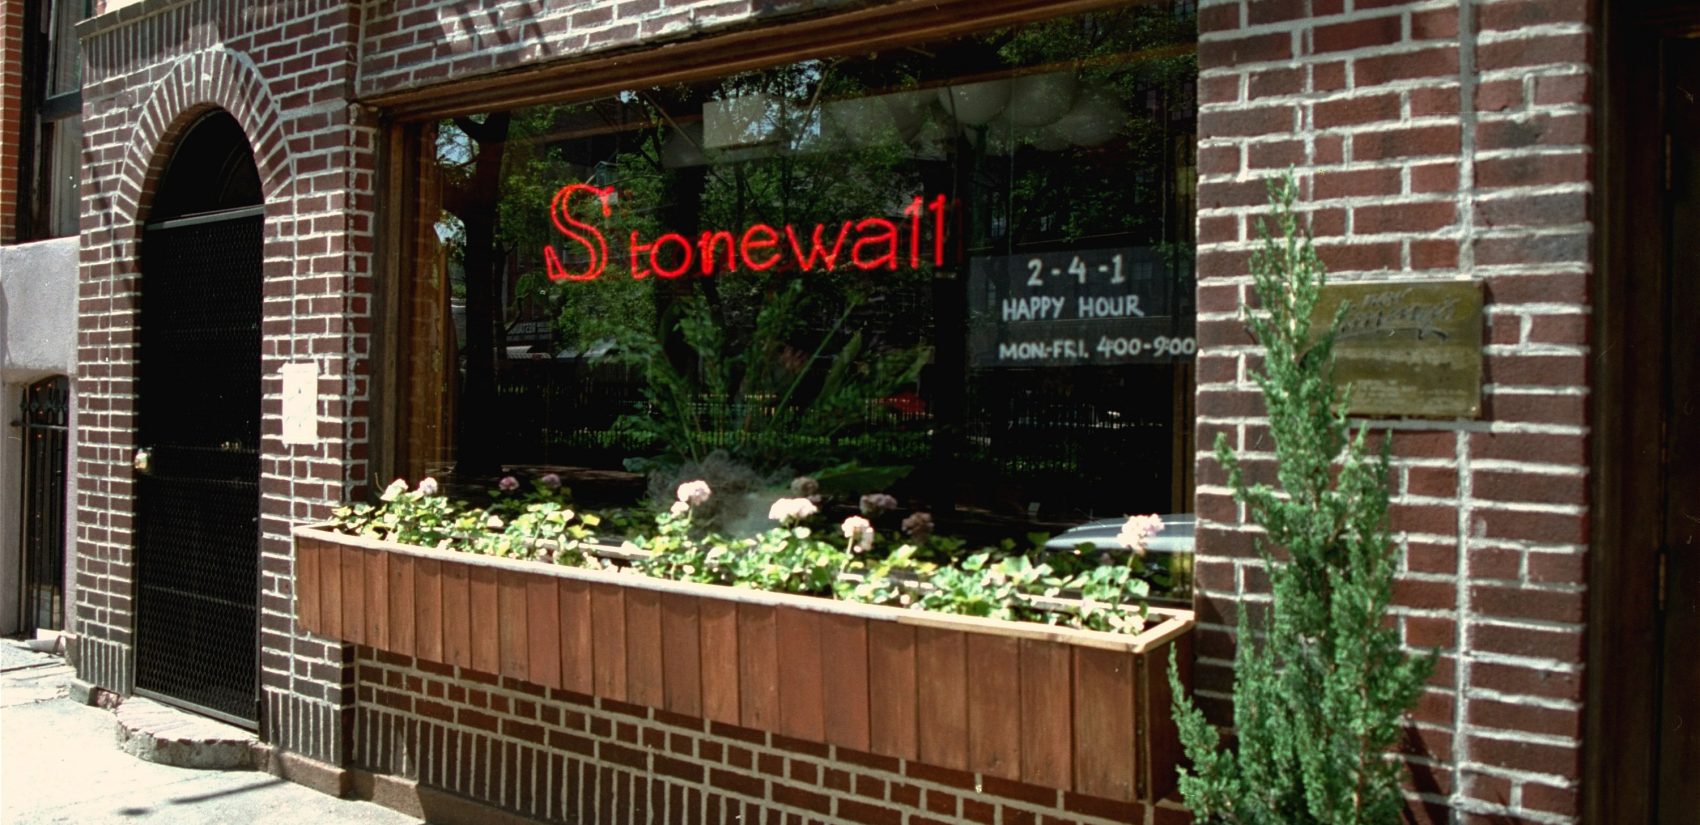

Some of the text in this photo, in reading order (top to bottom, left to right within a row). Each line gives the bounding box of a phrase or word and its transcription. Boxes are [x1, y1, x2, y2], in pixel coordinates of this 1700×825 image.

[543, 183, 947, 282] Stonewall
[1002, 295, 1145, 322] HAPPY HOUR
